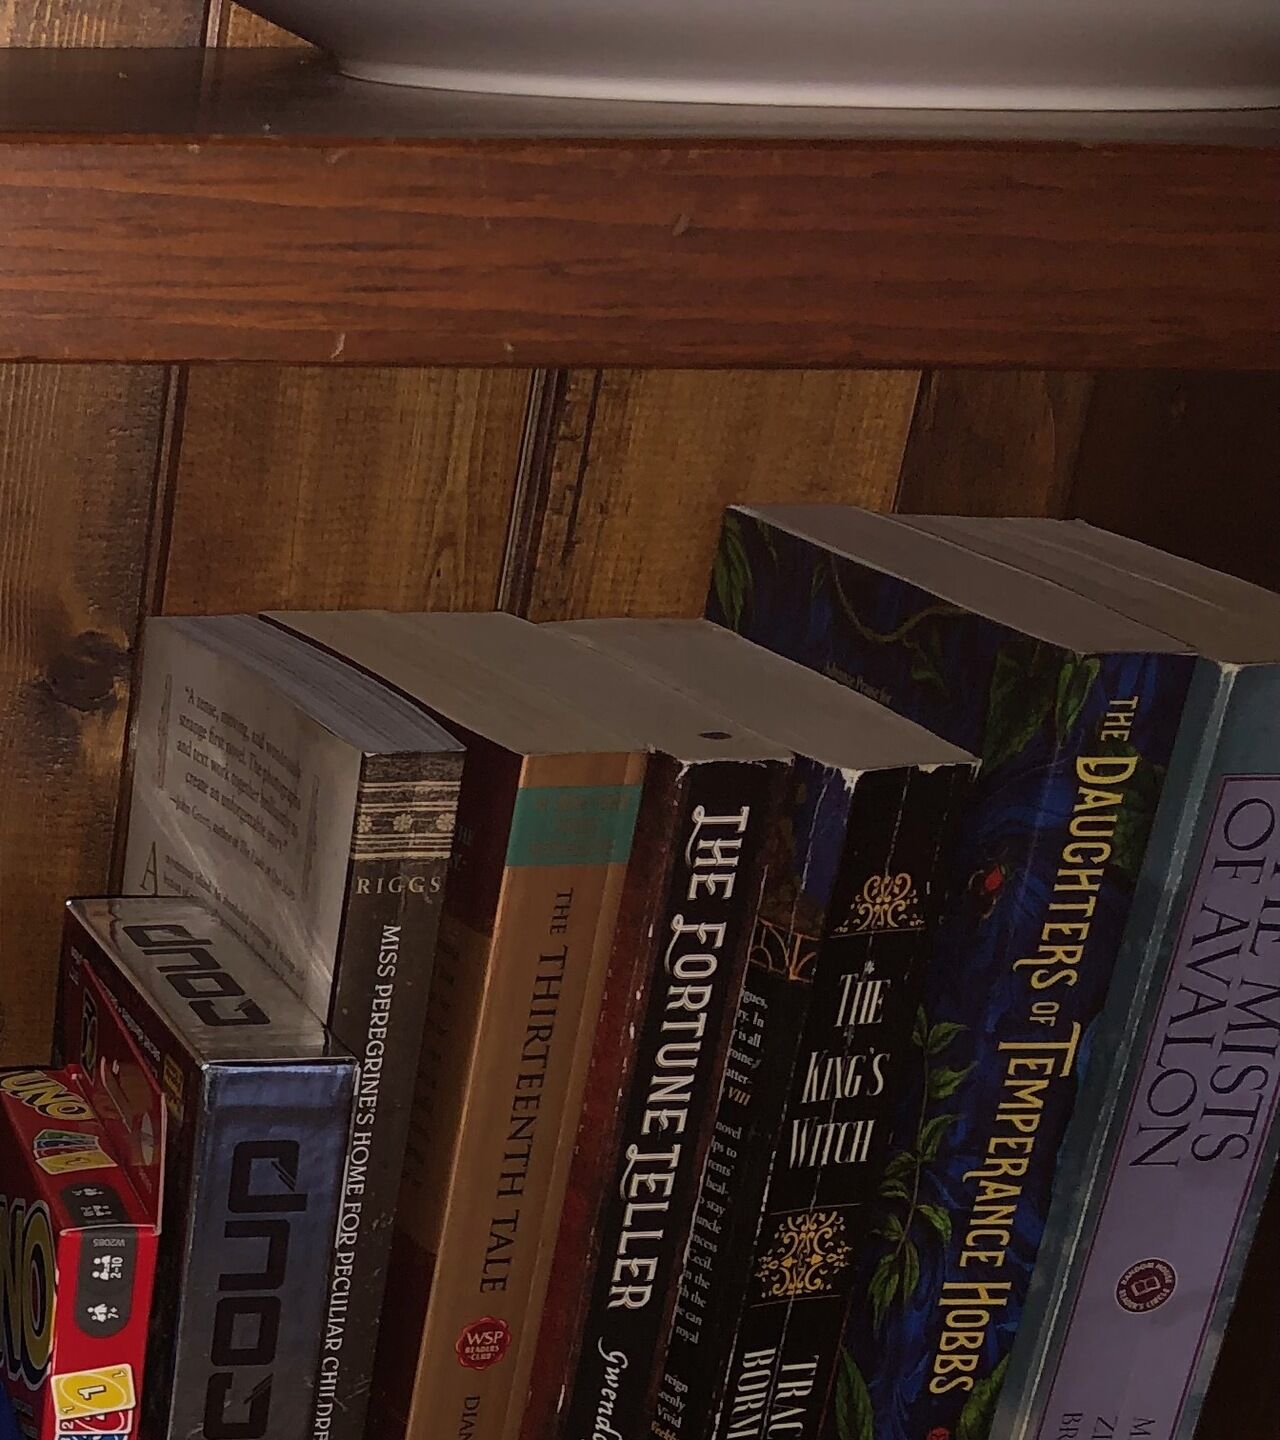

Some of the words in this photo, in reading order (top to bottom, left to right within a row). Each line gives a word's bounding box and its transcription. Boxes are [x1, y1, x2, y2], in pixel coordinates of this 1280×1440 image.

[1099, 695, 1139, 742] THE
[684, 803, 750, 901] THE
[1011, 754, 1139, 990] DAUGHTERS
[1212, 797, 1277, 885] OF
[355, 875, 441, 895] RIGGS
[548, 886, 574, 935] THE
[376, 924, 402, 976] MISS
[643, 912, 727, 1137] FORTUNE
[834, 973, 892, 1028] THE
[1028, 1000, 1060, 1027] OF
[1128, 901, 1251, 1168] AVALON
[356, 984, 393, 1127] PEREGRINE'S
[495, 943, 568, 1200] THIRTEENTH
[801, 1047, 891, 1104] KING'S
[1190, 977, 1280, 1163] MISTS
[343, 1130, 373, 1198] HOME
[788, 1119, 877, 1169] WITCH
[959, 1021, 1082, 1268] TEMPERANCE
[109, 1255, 124, 1281] 2-10
[339, 1200, 362, 1250] FOR
[478, 1209, 520, 1295] TALE
[607, 1142, 682, 1310] TELLER
[324, 1250, 355, 1351] PECULIAR
[466, 1330, 505, 1346] WSP
[928, 1281, 1013, 1395] HOBBS
